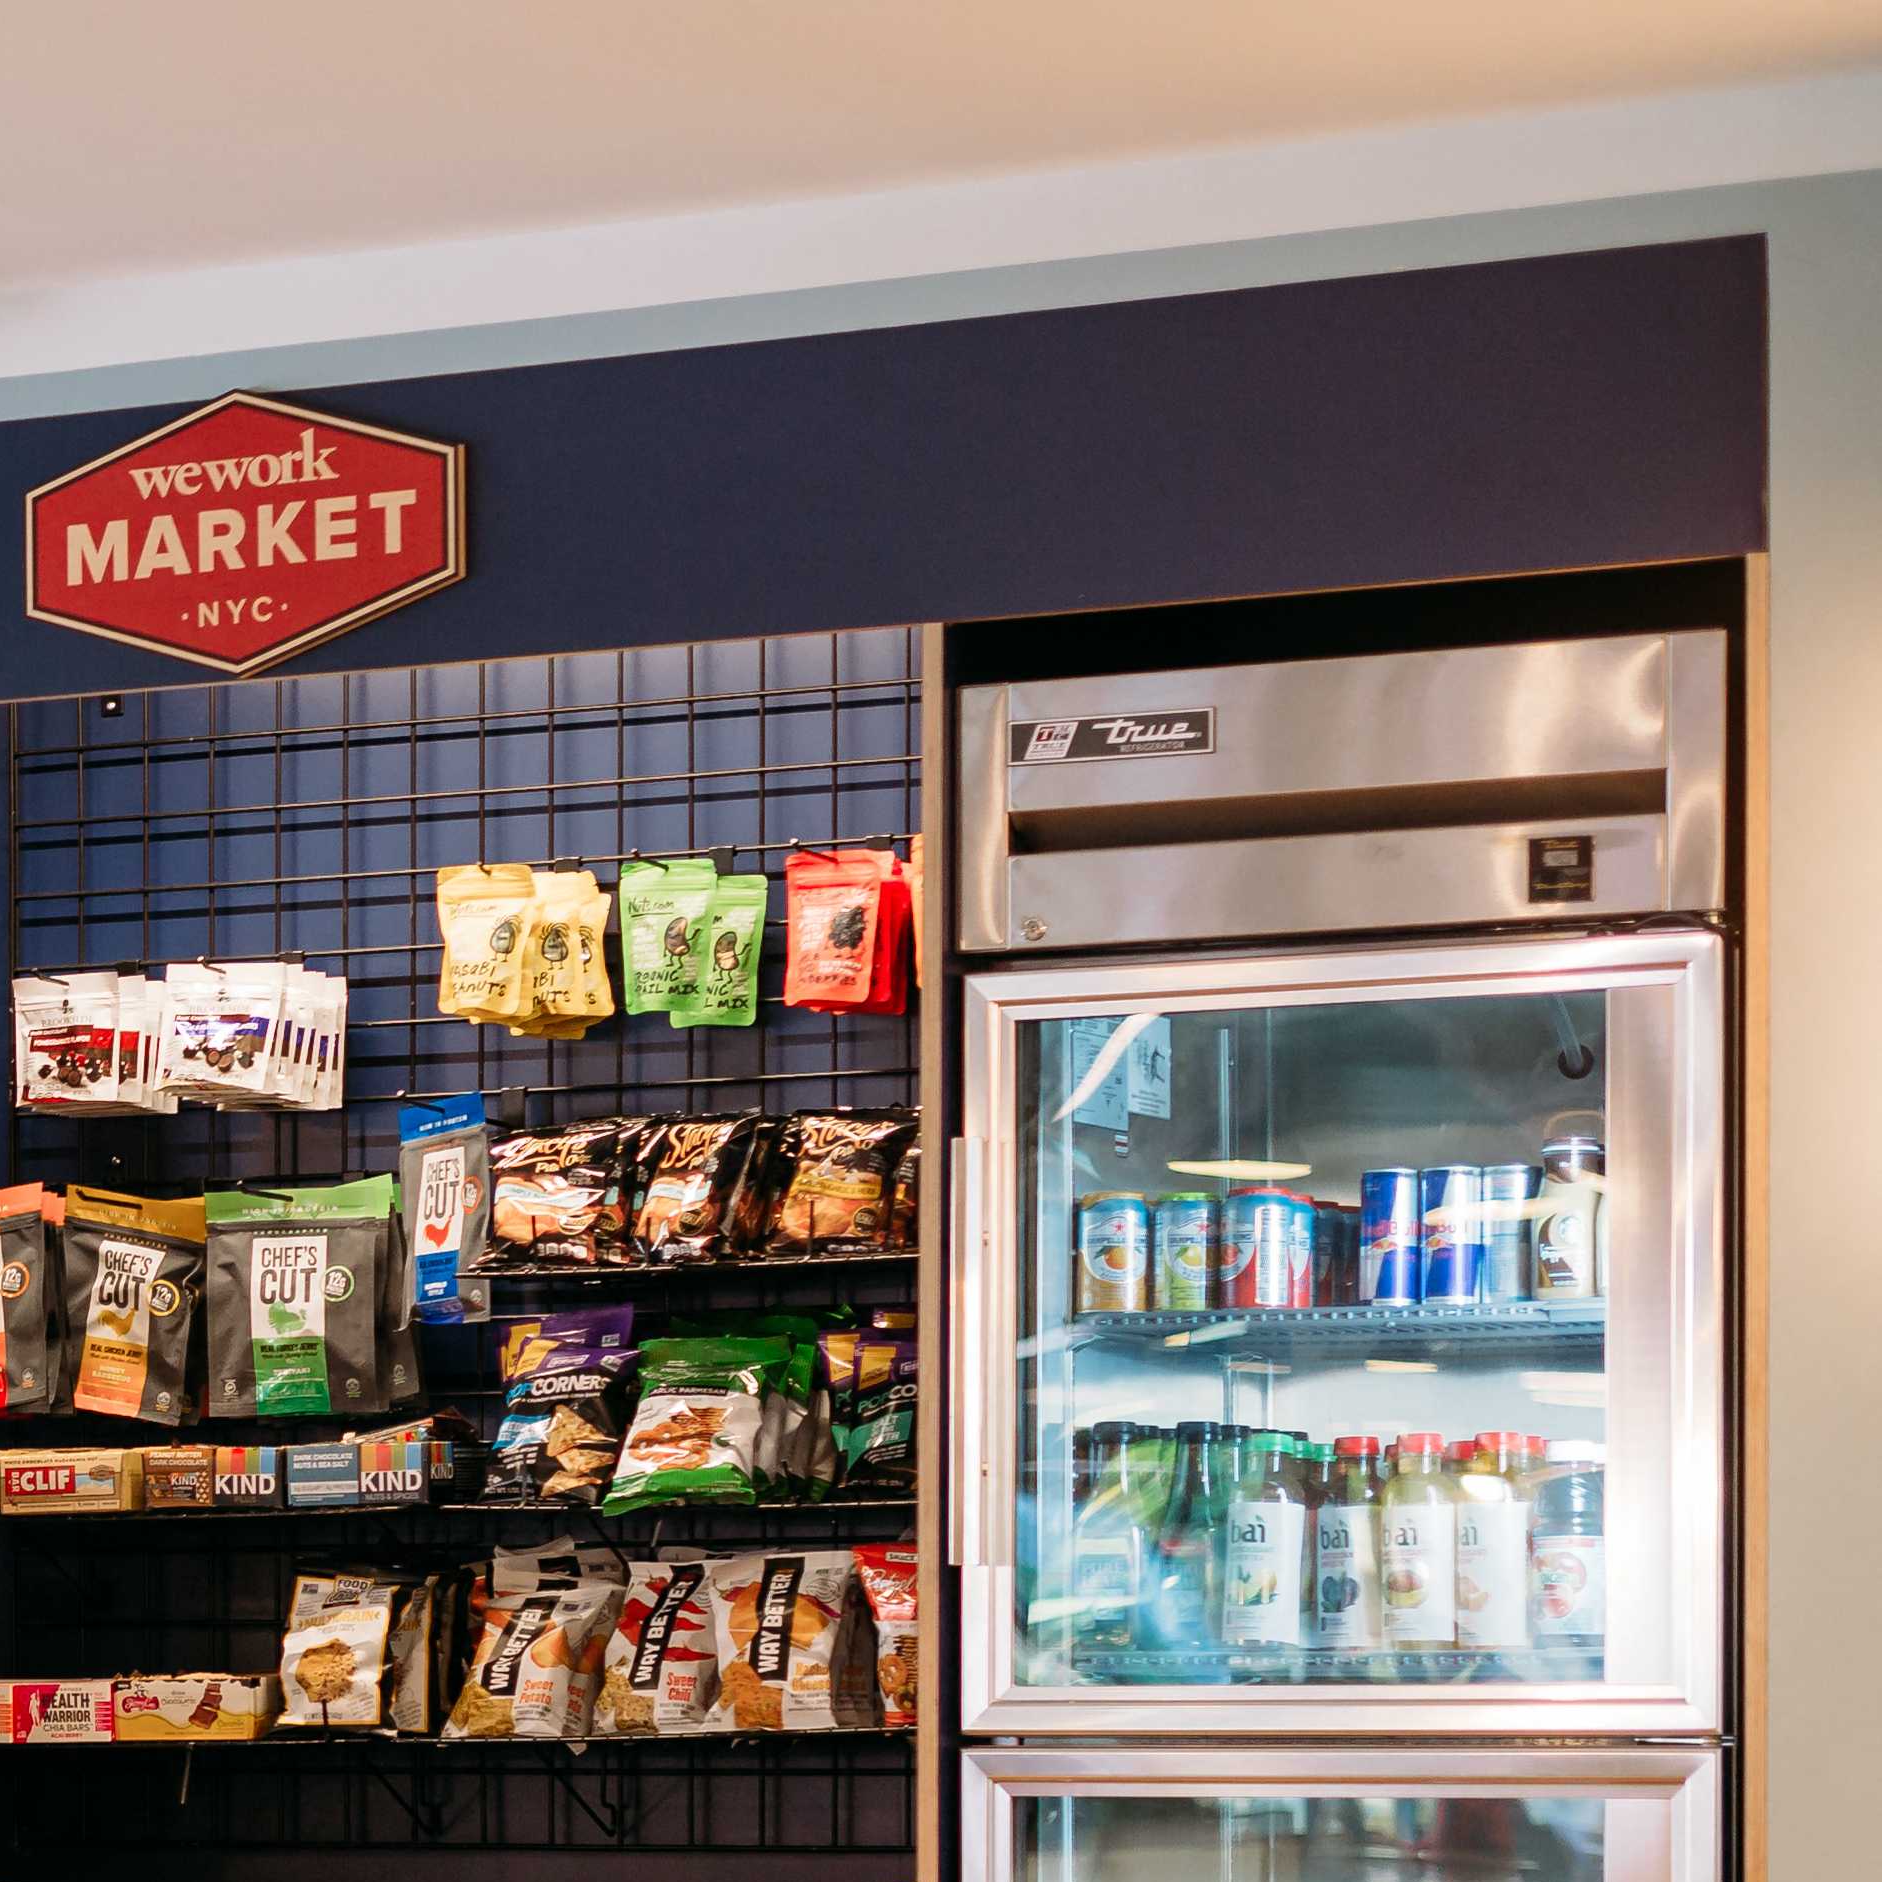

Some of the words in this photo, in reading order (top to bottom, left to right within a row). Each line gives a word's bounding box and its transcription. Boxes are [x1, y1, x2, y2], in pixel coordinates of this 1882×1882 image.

[128, 428, 339, 500] wework
[66, 489, 417, 587] MARKET
[427, 1158, 460, 1183] CHEF'S
[424, 1180, 460, 1220] CUT
[105, 1250, 153, 1276] CHEF'S
[261, 1246, 317, 1268] CHEF'S
[98, 1272, 146, 1311] CUT
[259, 1267, 317, 1305] CUT
[678, 1387, 727, 1396] PARMESAN
[313, 1453, 354, 1461] CHOCOLATE
[20, 1468, 70, 1491] CLIF
[171, 1474, 197, 1487] KIND
[361, 1470, 423, 1492] KIND
[430, 1463, 454, 1480] KIND
[215, 1474, 276, 1496] KIND
[1231, 1515, 1266, 1545] bai
[1320, 1519, 1349, 1550] bai
[337, 1578, 372, 1591] FOOD
[647, 1580, 694, 1639] BETTER
[764, 1573, 793, 1627] BETTER
[758, 1631, 781, 1674] WAY
[635, 1645, 661, 1683] WAY
[524, 1679, 553, 1691] Sweet
[667, 1674, 697, 1687] Sweet
[43, 1692, 90, 1709] HEALTH
[520, 1692, 551, 1705] Potato
[668, 1688, 692, 1702] Chili
[43, 1710, 91, 1723] WARRIOR
[43, 1723, 65, 1732] CHIA
[66, 1723, 90, 1732] BARS
